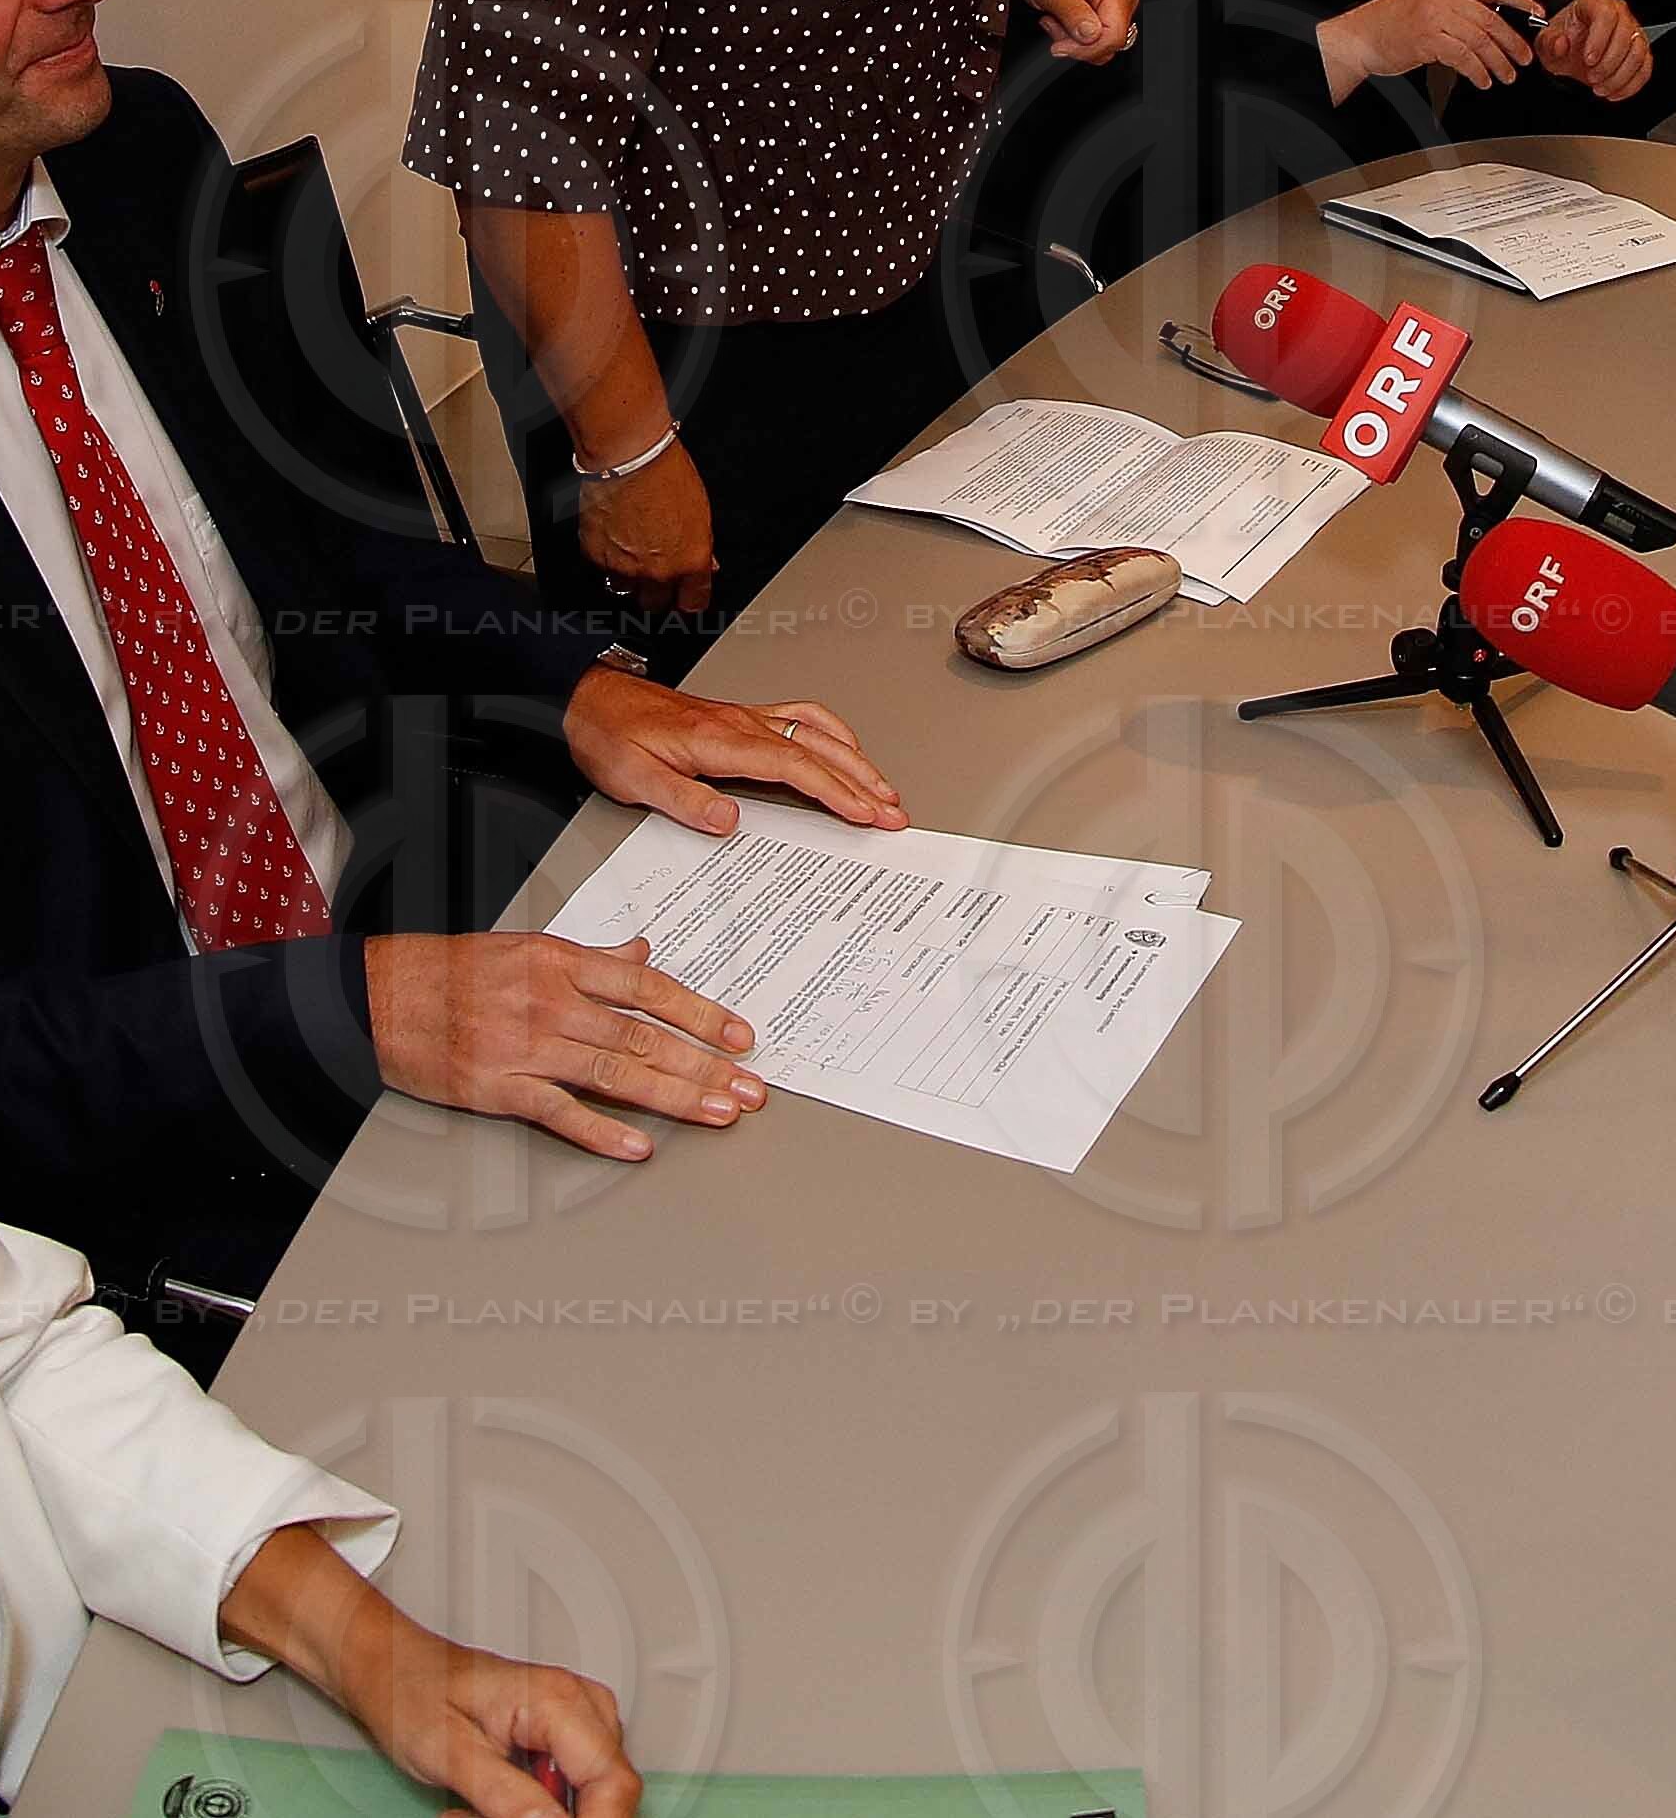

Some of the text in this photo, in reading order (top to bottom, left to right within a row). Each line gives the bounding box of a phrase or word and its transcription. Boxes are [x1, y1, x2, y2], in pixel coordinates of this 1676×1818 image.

[1254, 274, 1301, 331] ORF
[1342, 316, 1437, 459] ORF
[1511, 555, 1567, 634] ORF
